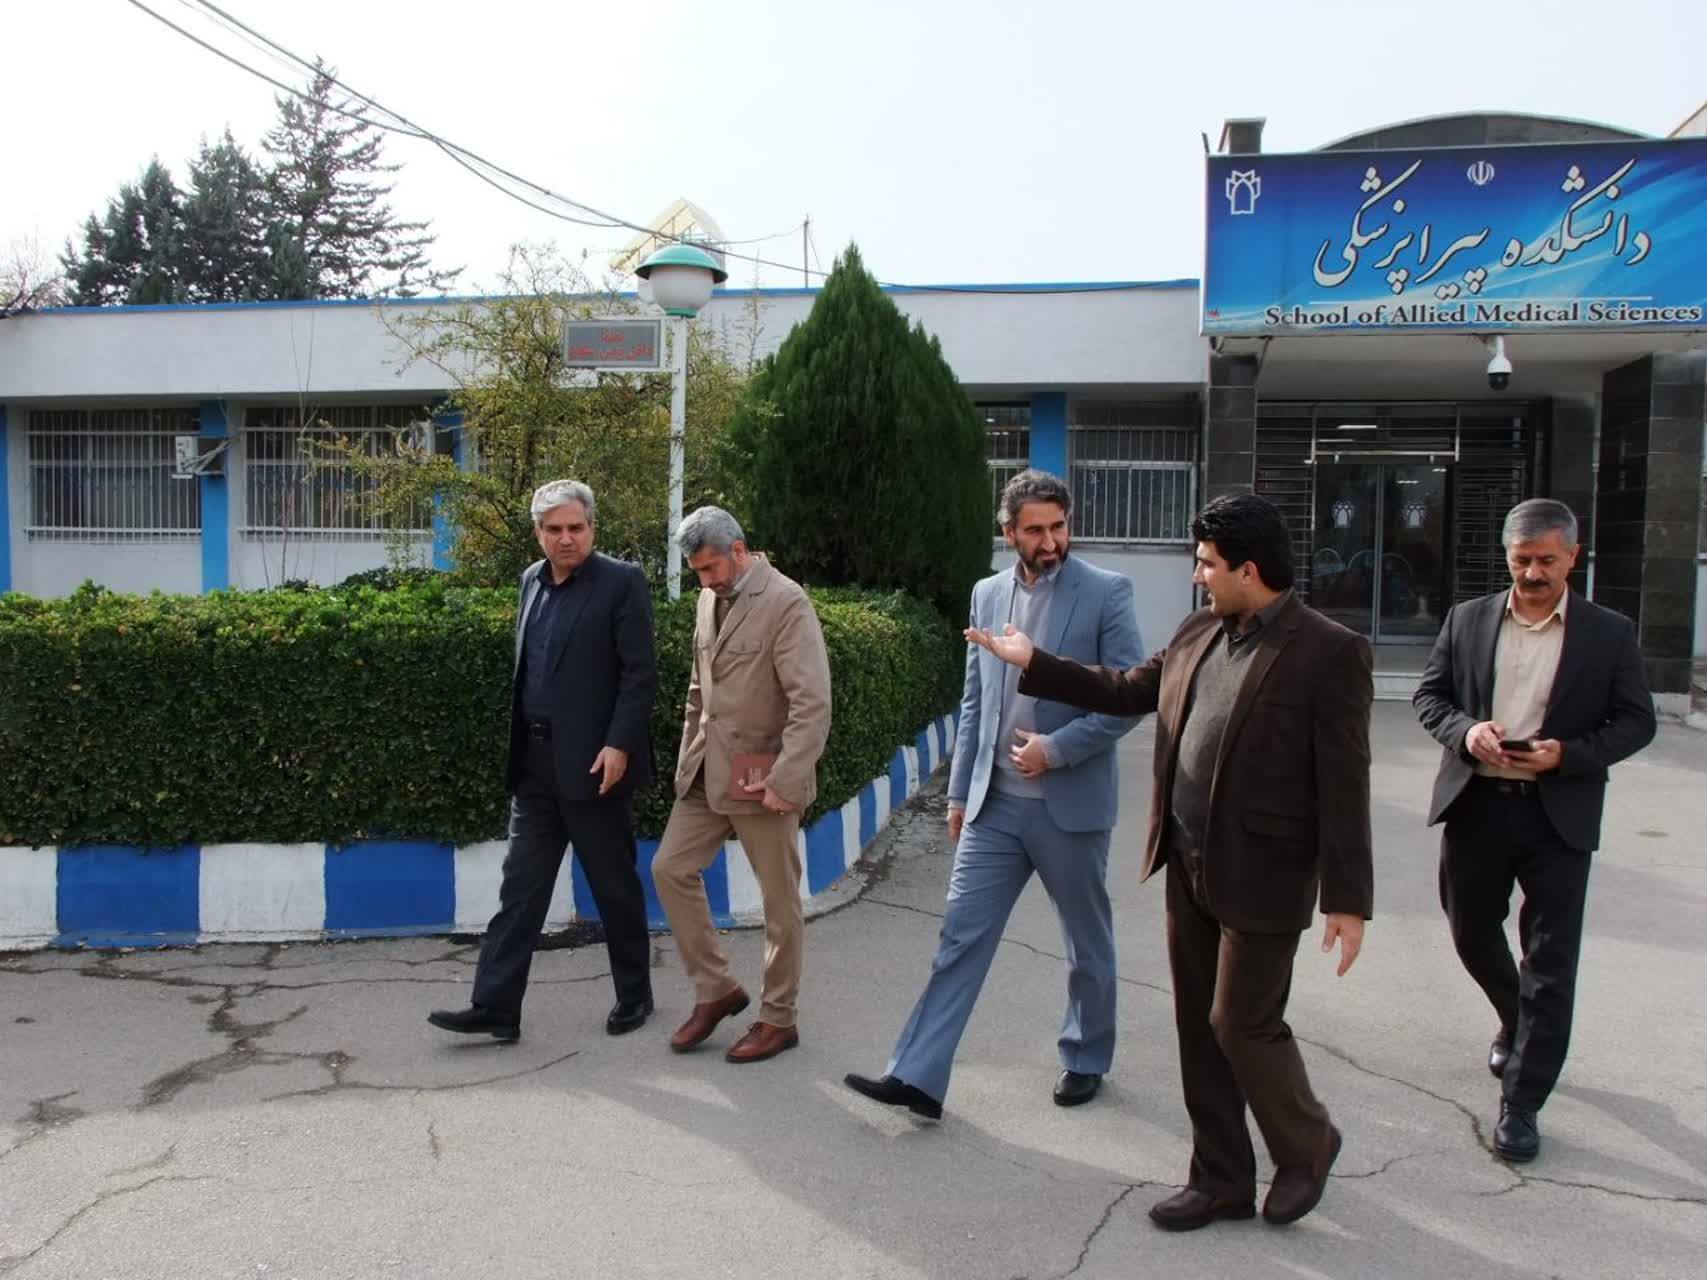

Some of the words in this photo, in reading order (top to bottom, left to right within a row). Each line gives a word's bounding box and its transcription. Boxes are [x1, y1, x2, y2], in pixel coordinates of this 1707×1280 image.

[1501, 157, 1652, 268] دانشکده
[1264, 305, 1349, 326] School
[1357, 305, 1387, 324] of
[1391, 303, 1466, 324] Allied
[1475, 302, 1579, 322] Medical
[1587, 302, 1702, 322] Sciences
